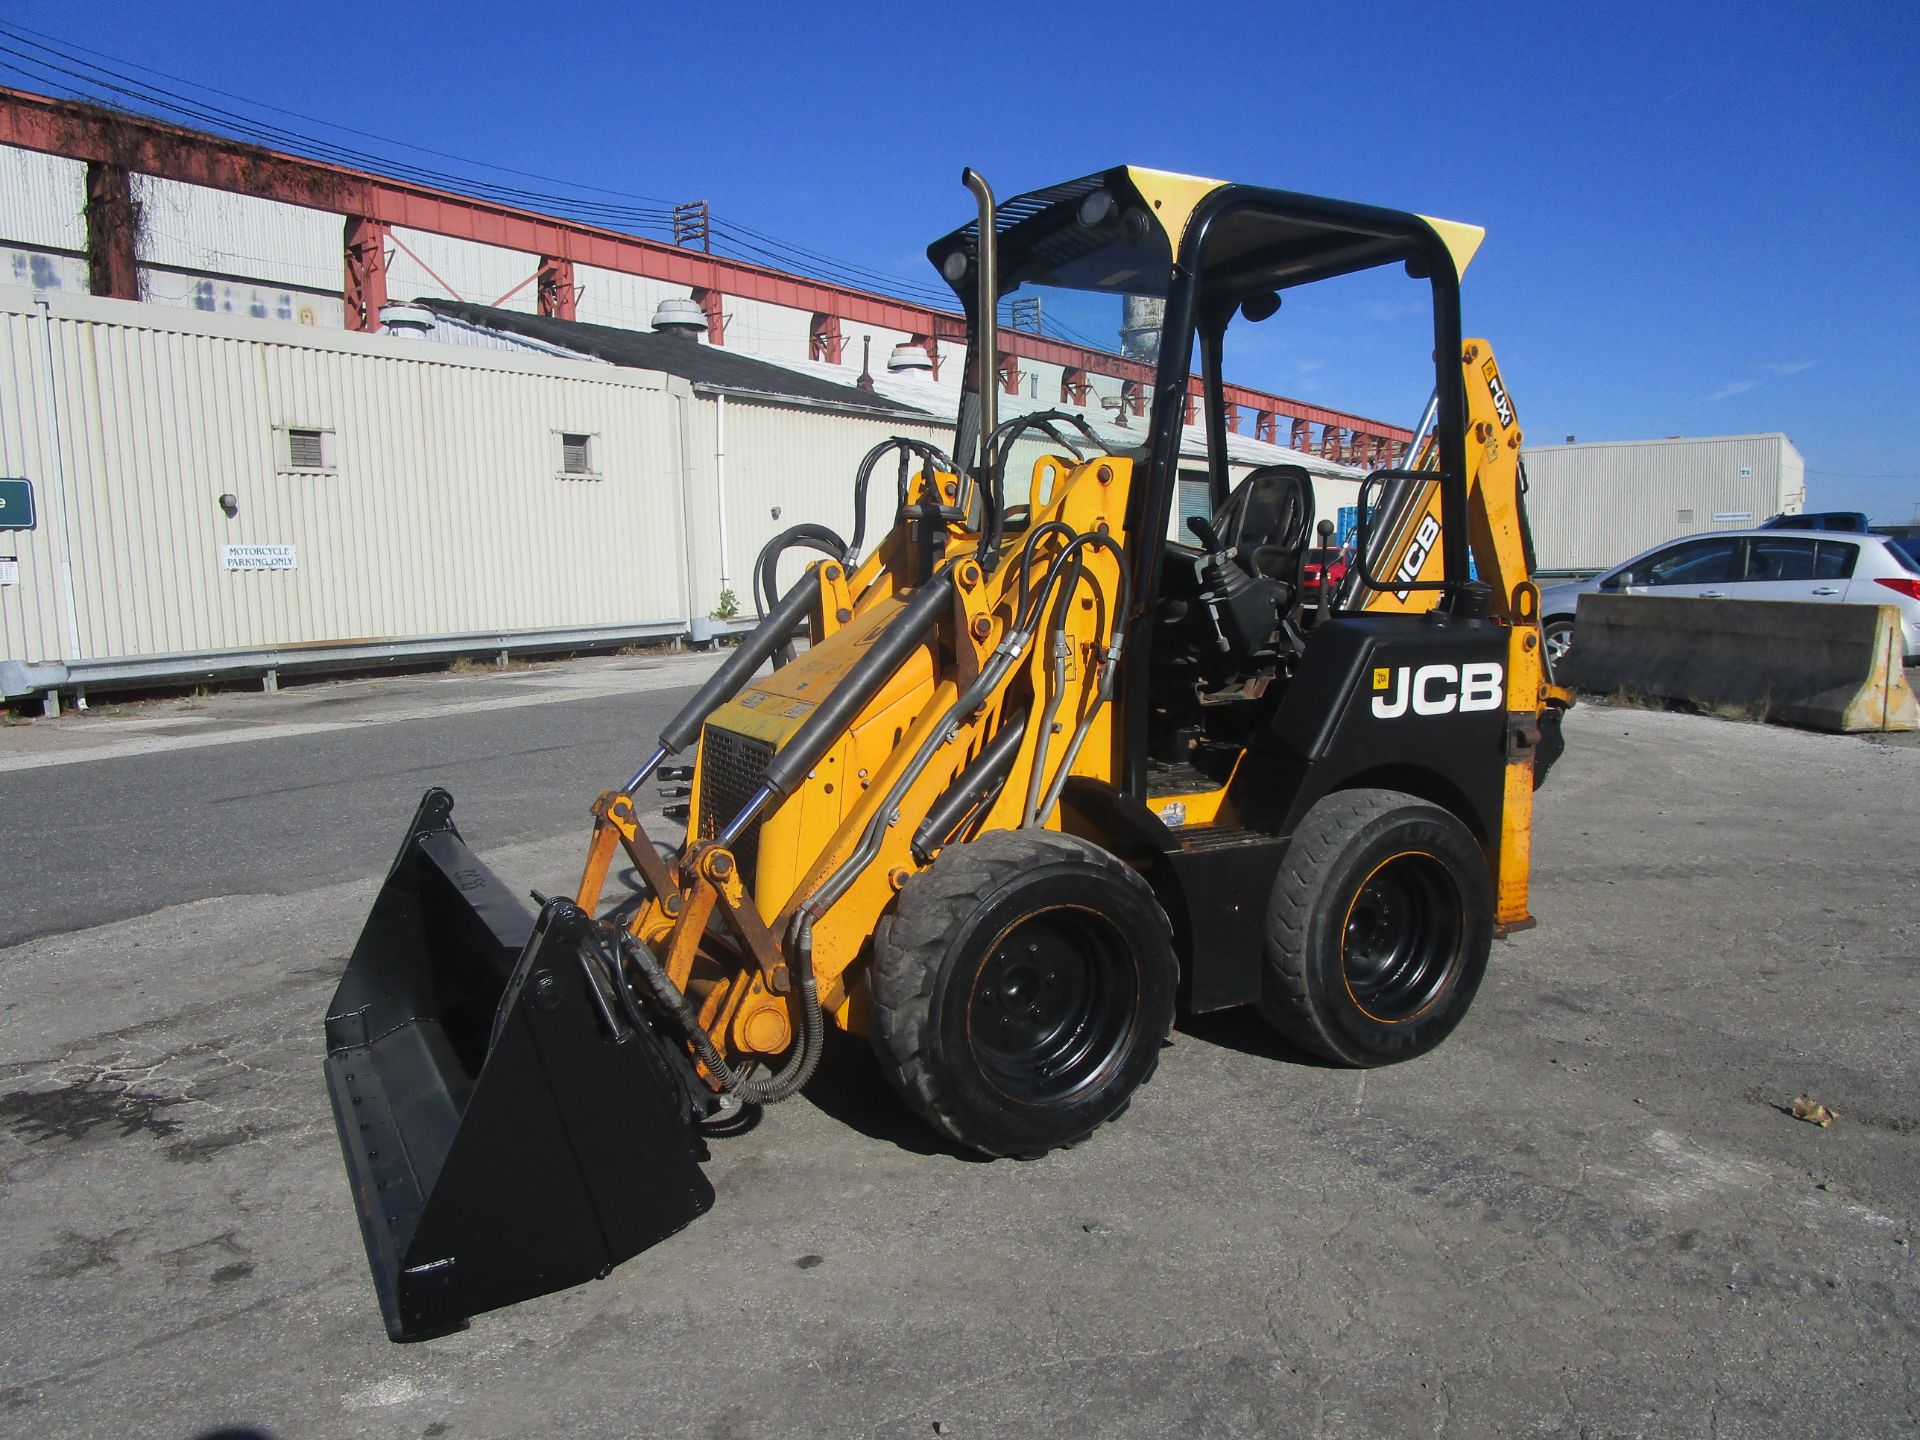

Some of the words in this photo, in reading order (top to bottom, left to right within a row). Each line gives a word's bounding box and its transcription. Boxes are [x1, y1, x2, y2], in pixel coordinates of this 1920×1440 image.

[227, 558, 268, 567] PARKING
[271, 557, 293, 566] ONLY
[229, 547, 290, 556] MOTORCYCLE
[1397, 516, 1439, 600] JCB
[1371, 662, 1503, 719] JCB
